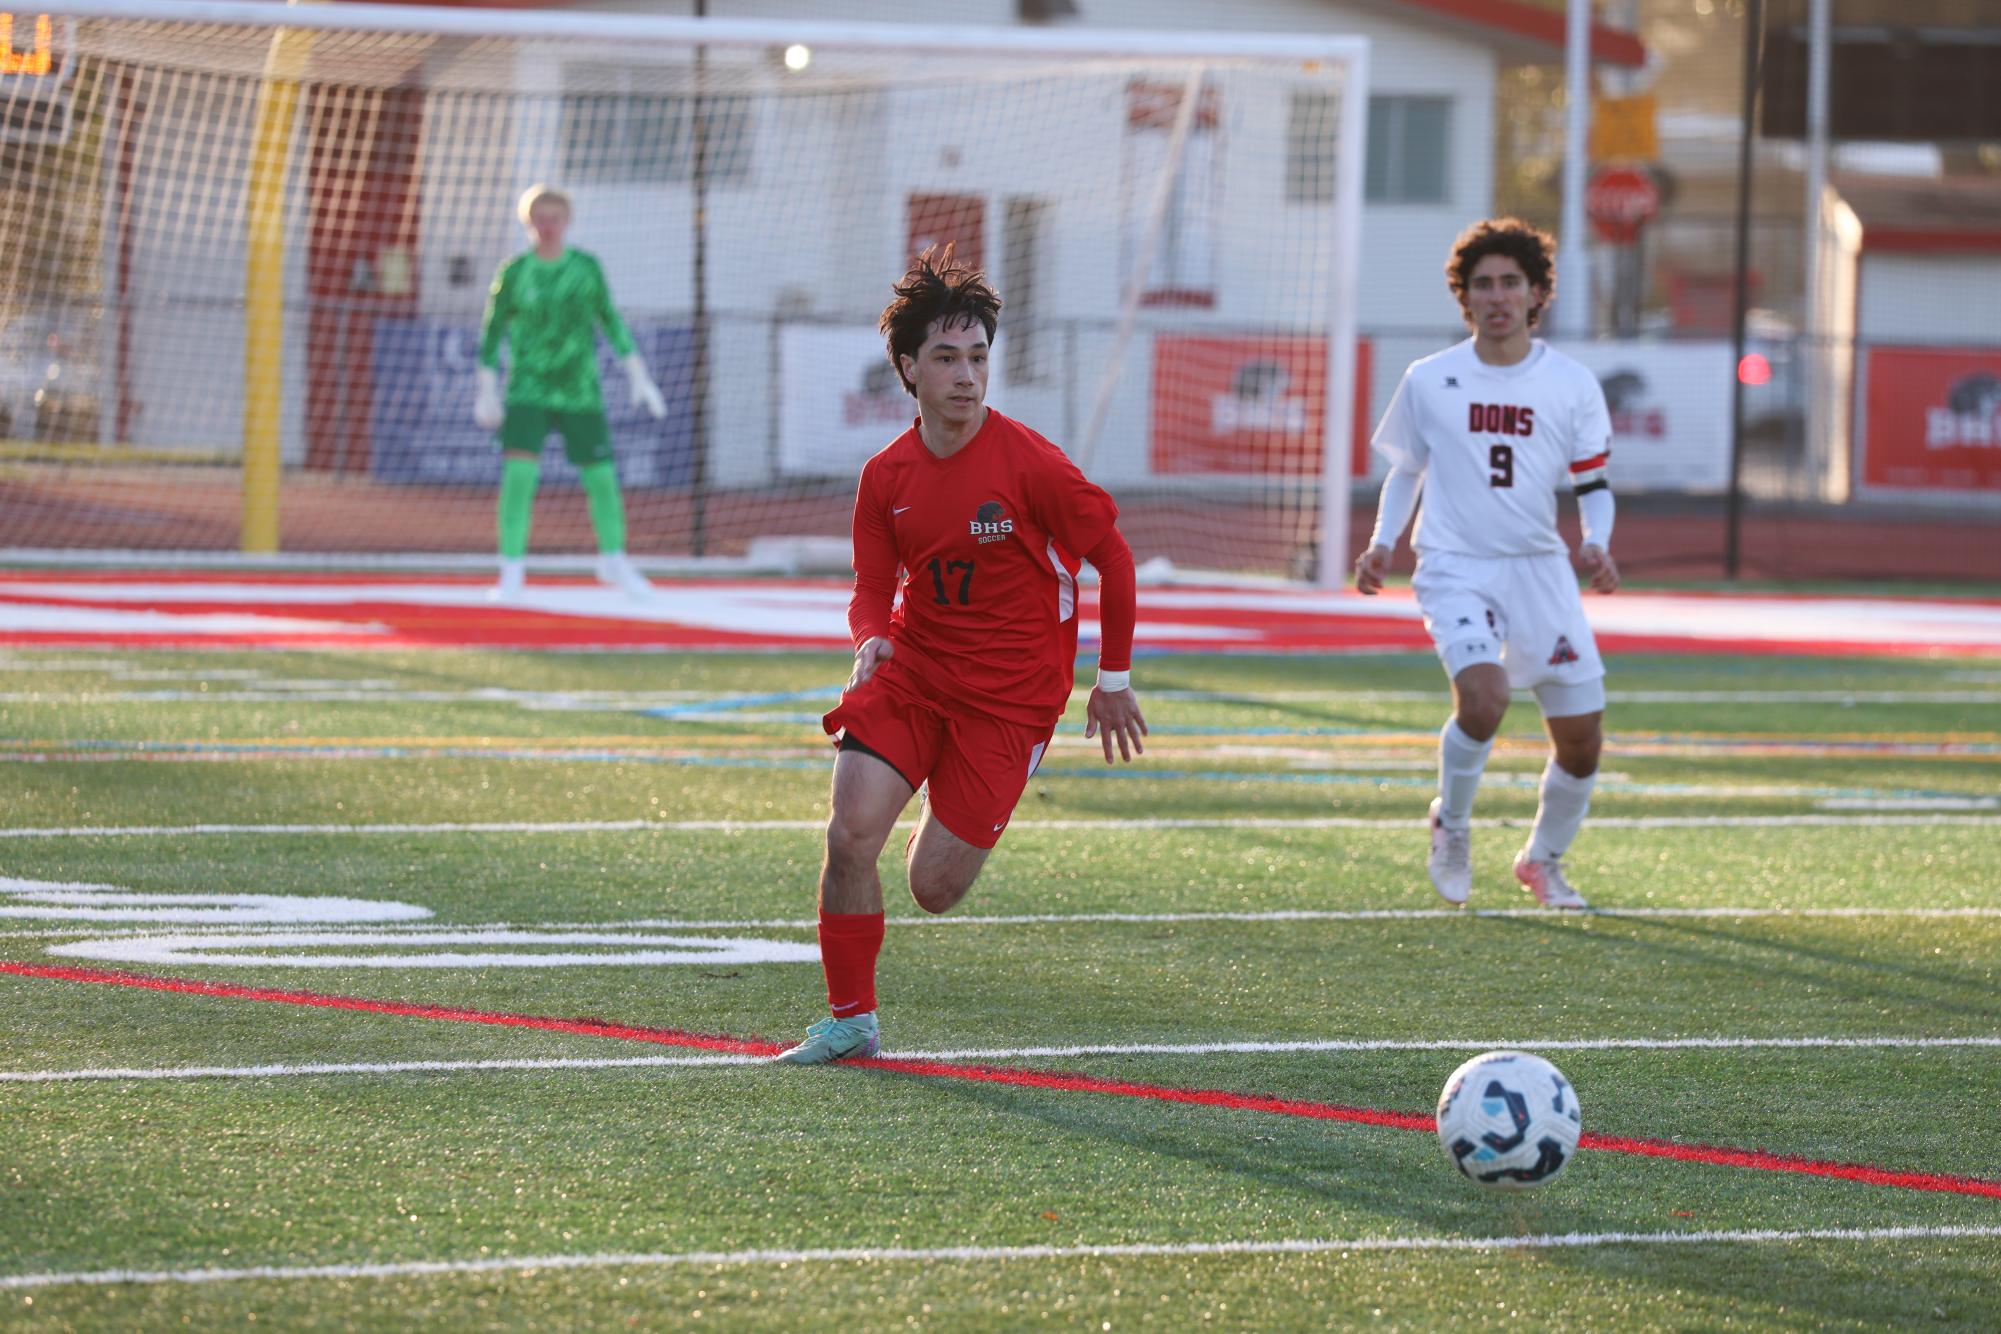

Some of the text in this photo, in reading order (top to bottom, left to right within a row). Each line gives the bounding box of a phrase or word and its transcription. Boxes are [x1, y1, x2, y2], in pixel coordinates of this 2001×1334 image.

[1469, 403, 1534, 436] DONS
[1489, 444, 1514, 488] 9
[969, 519, 1013, 535] BHS
[978, 534, 1006, 545] SOCCER
[928, 557, 976, 606] 17
